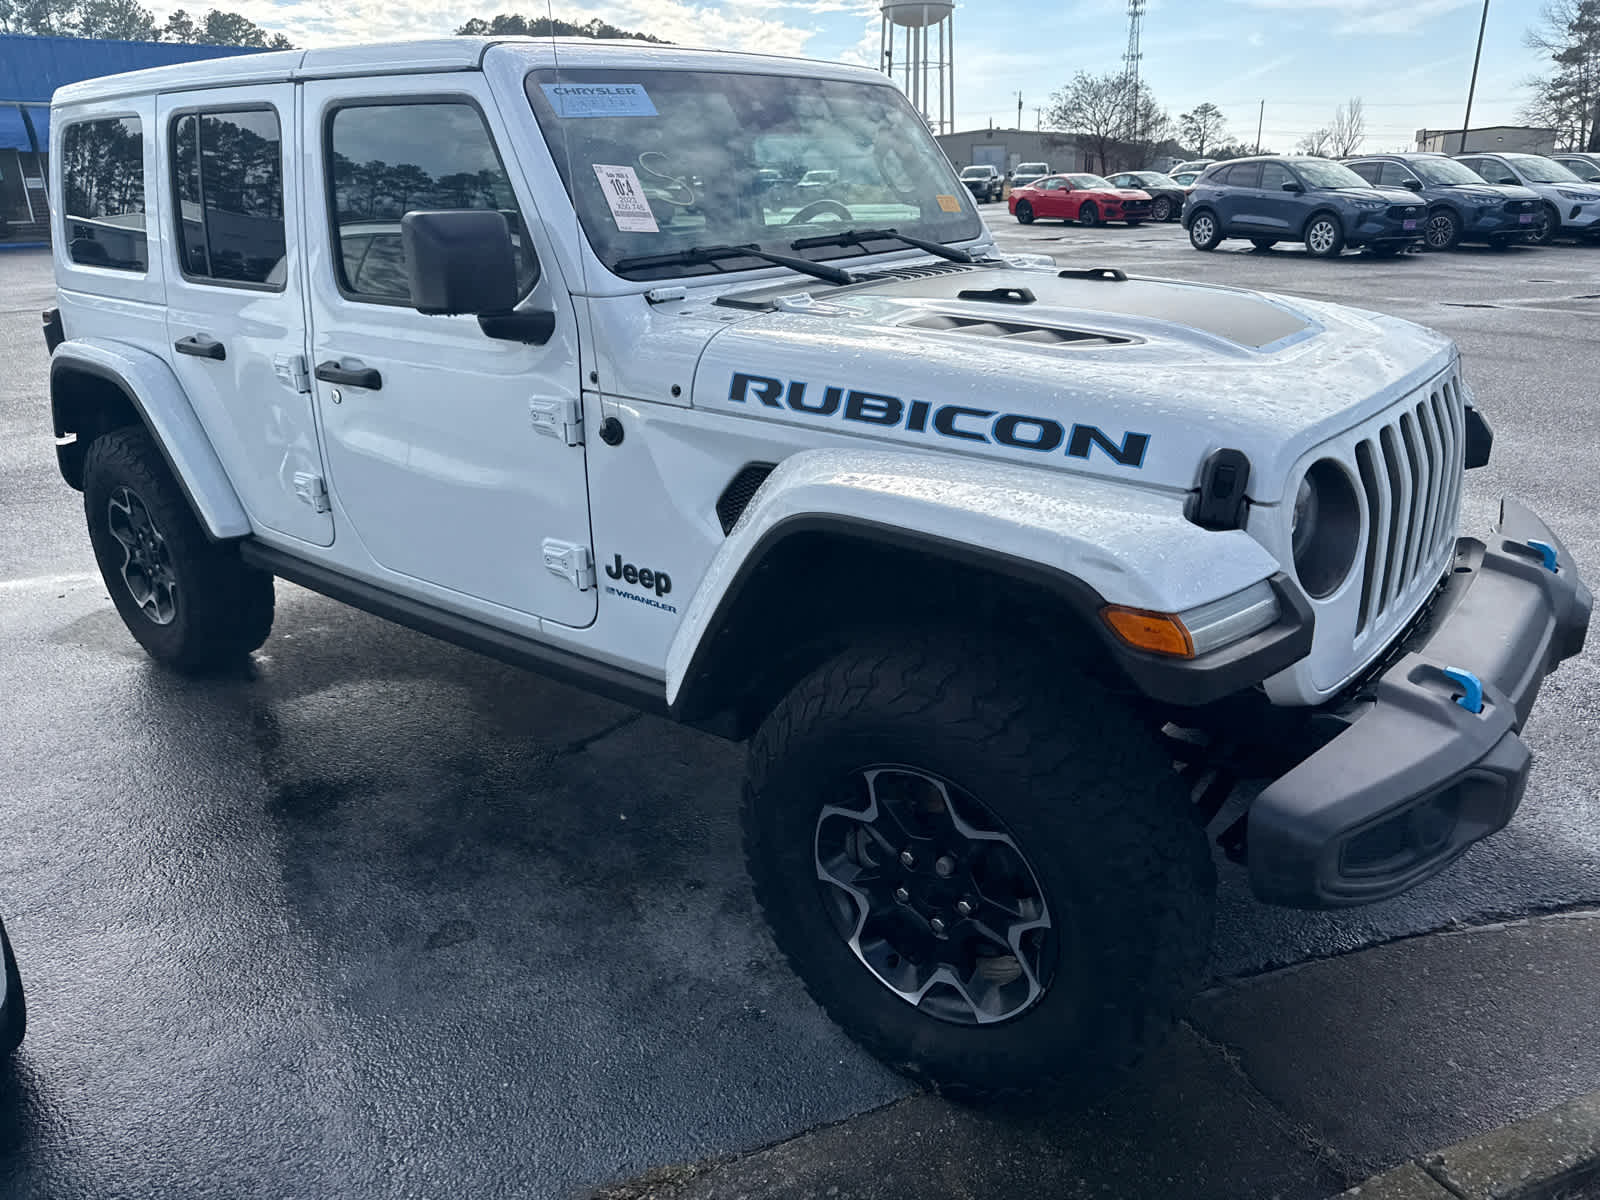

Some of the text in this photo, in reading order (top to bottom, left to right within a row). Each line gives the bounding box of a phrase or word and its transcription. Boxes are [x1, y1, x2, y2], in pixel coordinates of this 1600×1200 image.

[553, 87, 636, 96] CHRYSLER
[610, 179, 634, 196] 10:4
[728, 371, 1151, 469] RUBICON
[605, 553, 672, 597] Jeep
[616, 588, 677, 614] WRANGLER
